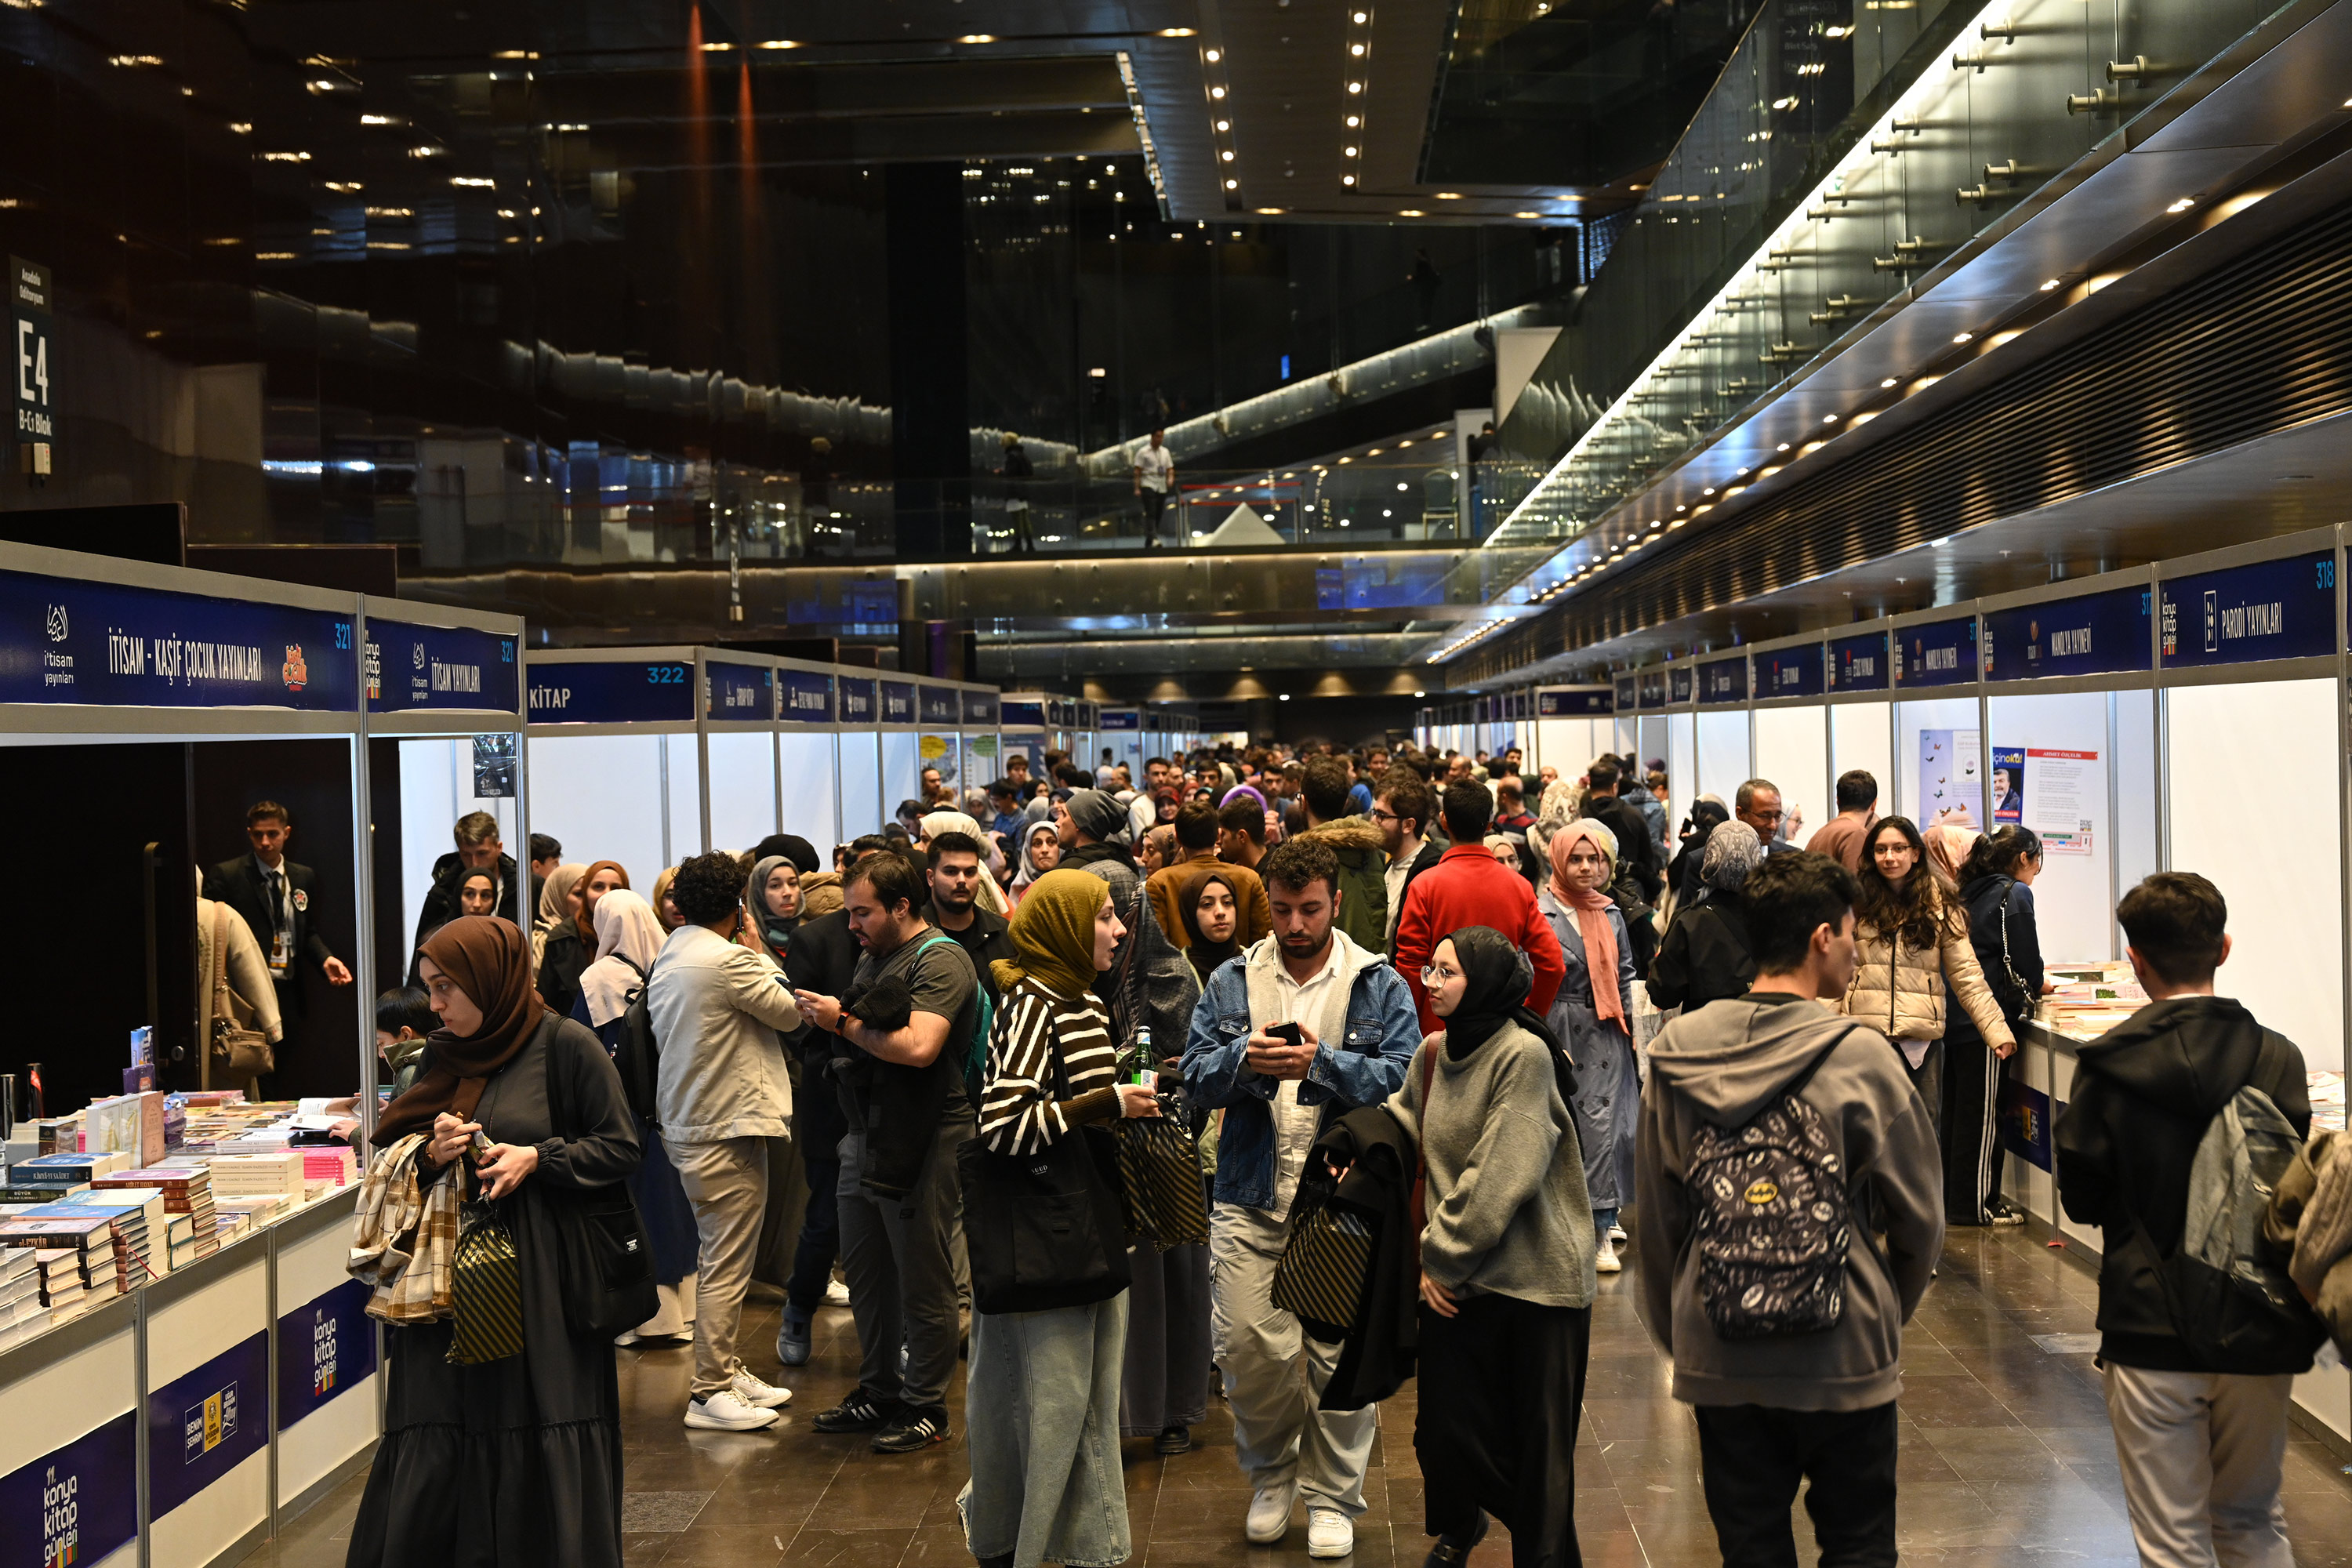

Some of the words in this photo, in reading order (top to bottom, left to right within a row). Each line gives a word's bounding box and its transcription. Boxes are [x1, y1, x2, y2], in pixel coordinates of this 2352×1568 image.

[22, 267, 41, 286] Anadolu
[20, 285, 44, 306] Oditoryum
[19, 319, 49, 406] E4
[35, 412, 52, 437] Blok
[2316, 560, 2334, 590] 318
[2162, 616, 2176, 636] kitap
[2222, 601, 2245, 640] PARODİ
[2246, 601, 2282, 637] YAYINLARI
[335, 623, 351, 650] 321
[108, 626, 144, 675] İTİSAM
[154, 632, 181, 685] KAŞİF
[186, 639, 216, 687] ÇOCUK
[216, 644, 262, 682] YAYINLARI
[365, 643, 380, 660] onya
[502, 641, 514, 663] 321
[45, 670, 74, 687] yayınları
[431, 655, 452, 691] İTİSAM
[452, 663, 481, 693] YAYINLARI
[647, 666, 684, 684] 322
[529, 684, 571, 710] KİTAP
[314, 1318, 336, 1342] konya
[314, 1338, 336, 1366] kitap
[314, 1356, 336, 1388] günleri
[187, 1416, 202, 1436] BENİM
[46, 1465, 56, 1486] 11.
[44, 1475, 78, 1510] konya
[44, 1501, 78, 1540] kitap
[45, 1523, 78, 1568] günleri
